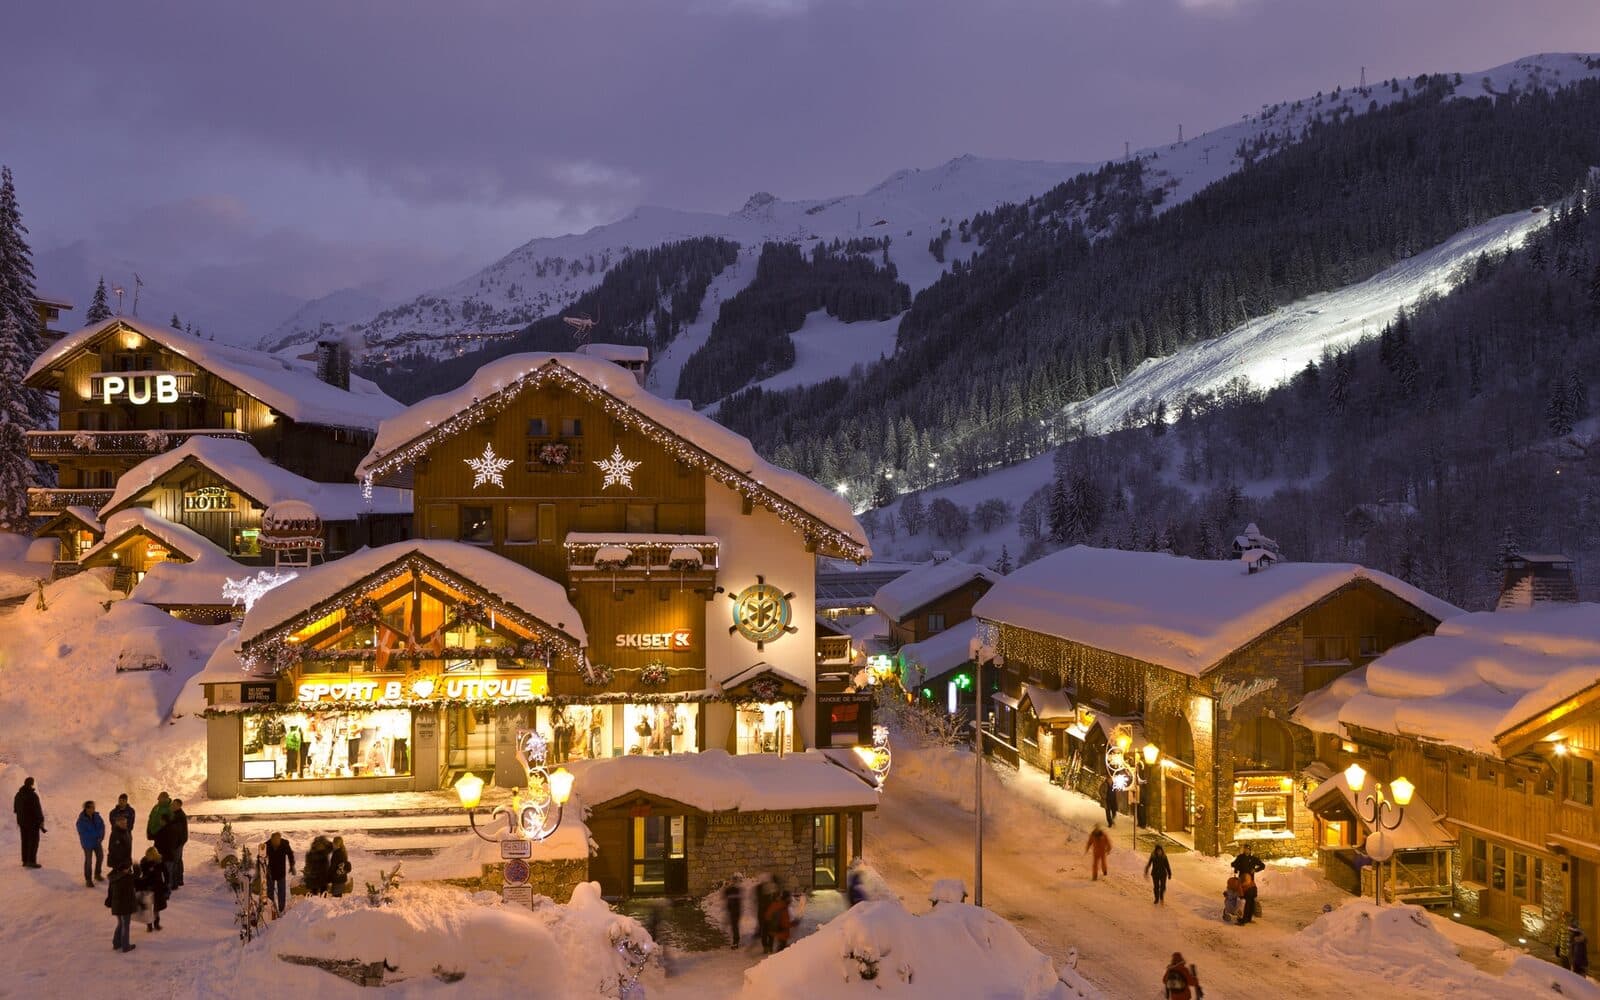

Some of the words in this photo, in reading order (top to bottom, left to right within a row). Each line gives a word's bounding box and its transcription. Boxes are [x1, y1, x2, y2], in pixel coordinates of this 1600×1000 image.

[103, 374, 179, 405] PUB
[615, 633, 673, 647] SKISET
[298, 682, 379, 701] SPORT
